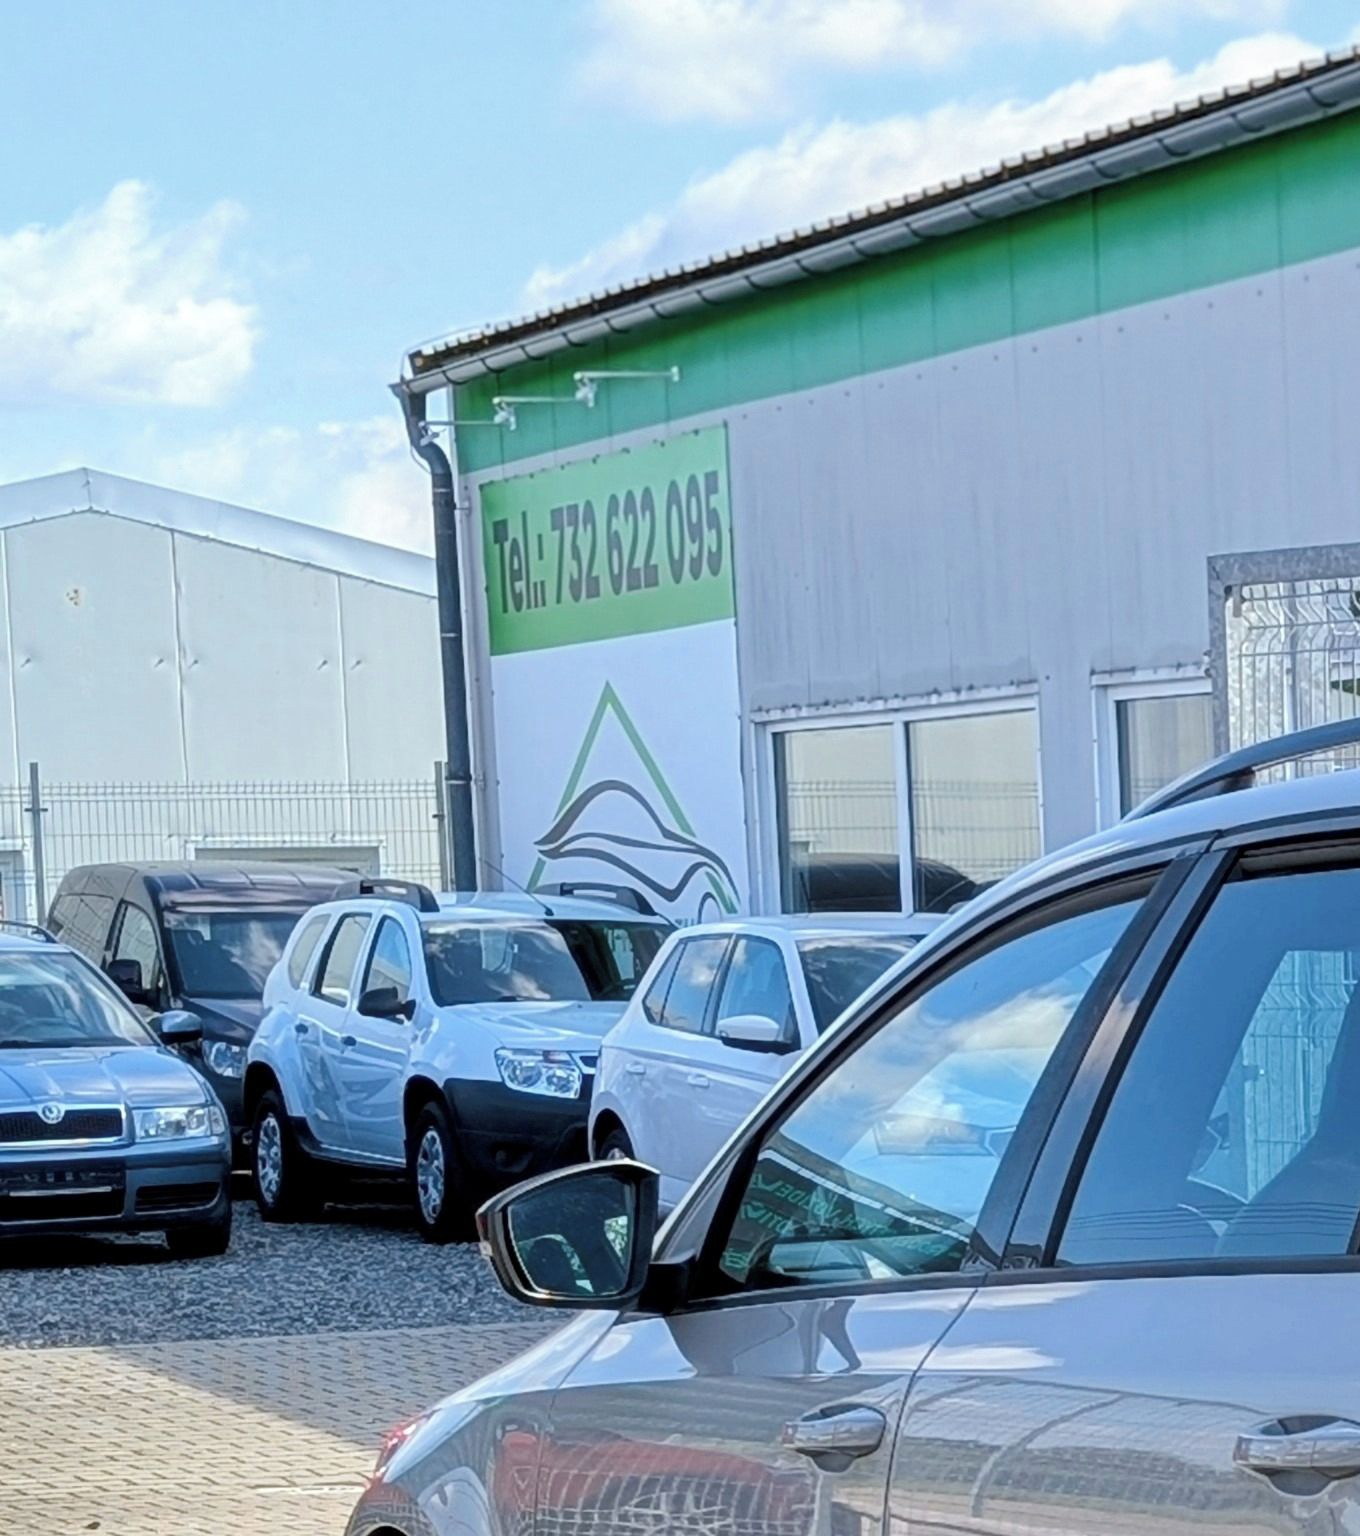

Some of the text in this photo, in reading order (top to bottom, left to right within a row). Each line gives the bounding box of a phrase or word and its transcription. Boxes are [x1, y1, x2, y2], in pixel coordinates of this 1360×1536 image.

[493, 470, 724, 615] Tel.: 732 622 095
